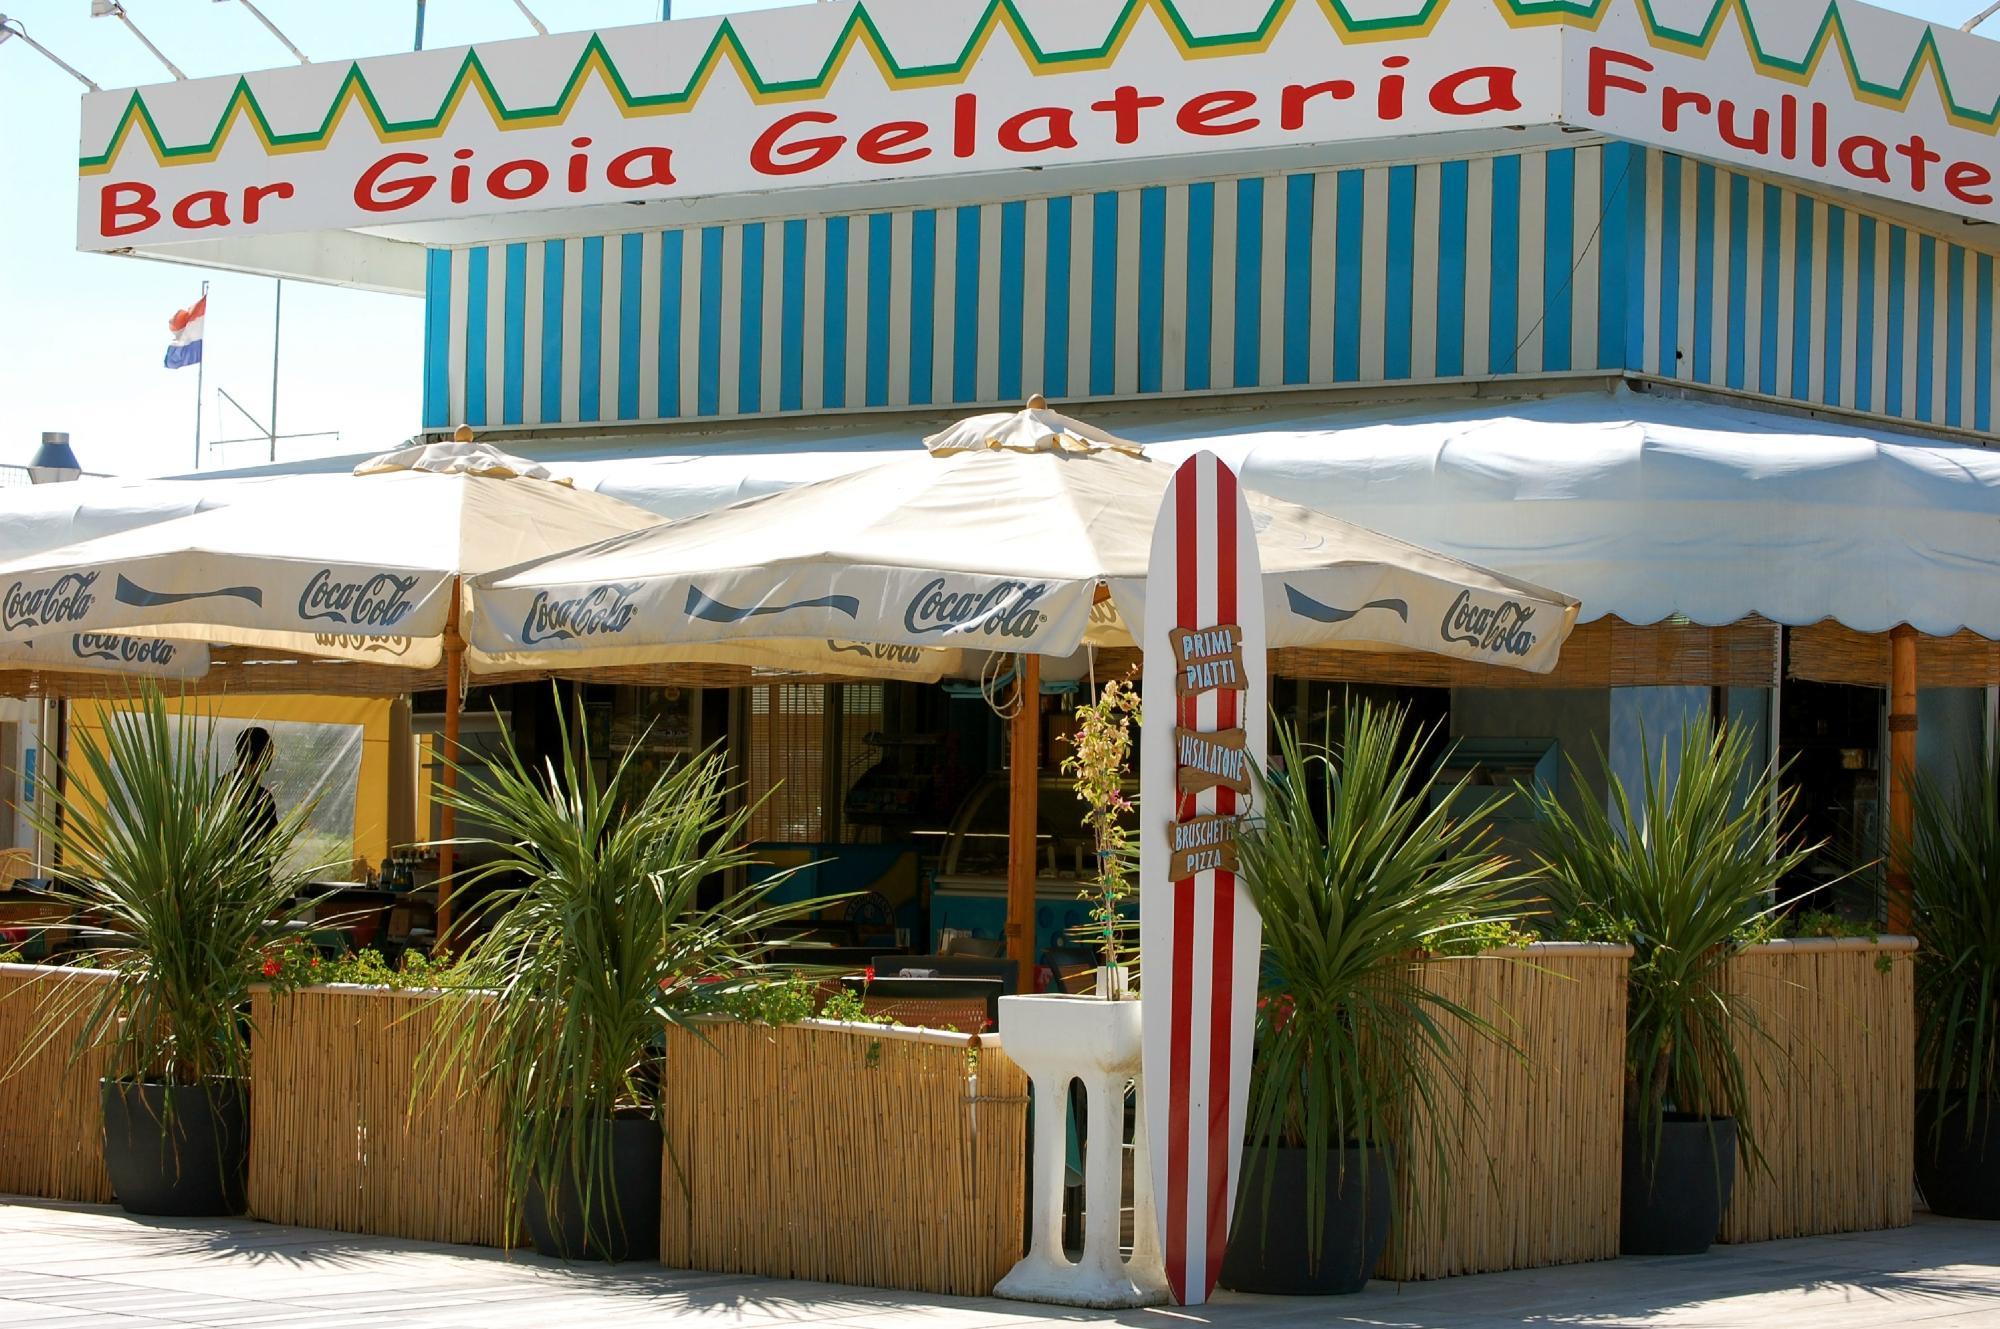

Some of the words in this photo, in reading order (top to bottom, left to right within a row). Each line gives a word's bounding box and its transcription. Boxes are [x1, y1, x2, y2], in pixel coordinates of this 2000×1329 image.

[100, 181, 294, 237] Bar
[353, 136, 677, 212] Gioia
[749, 55, 1522, 176] Gelateria
[1588, 46, 1994, 205] Frullate
[3, 570, 100, 631] Coca-Cola
[299, 569, 420, 626] Coca-Cola
[522, 582, 647, 644] Coca-Cola
[1441, 589, 1536, 656] Coca-Cola
[72, 633, 173, 665] CocaCola
[1182, 629, 1233, 661] PRIMI
[1186, 659, 1237, 689] PIATTI
[1180, 735, 1244, 782] INSALATONE
[1186, 848, 1221, 872] PIZZA
